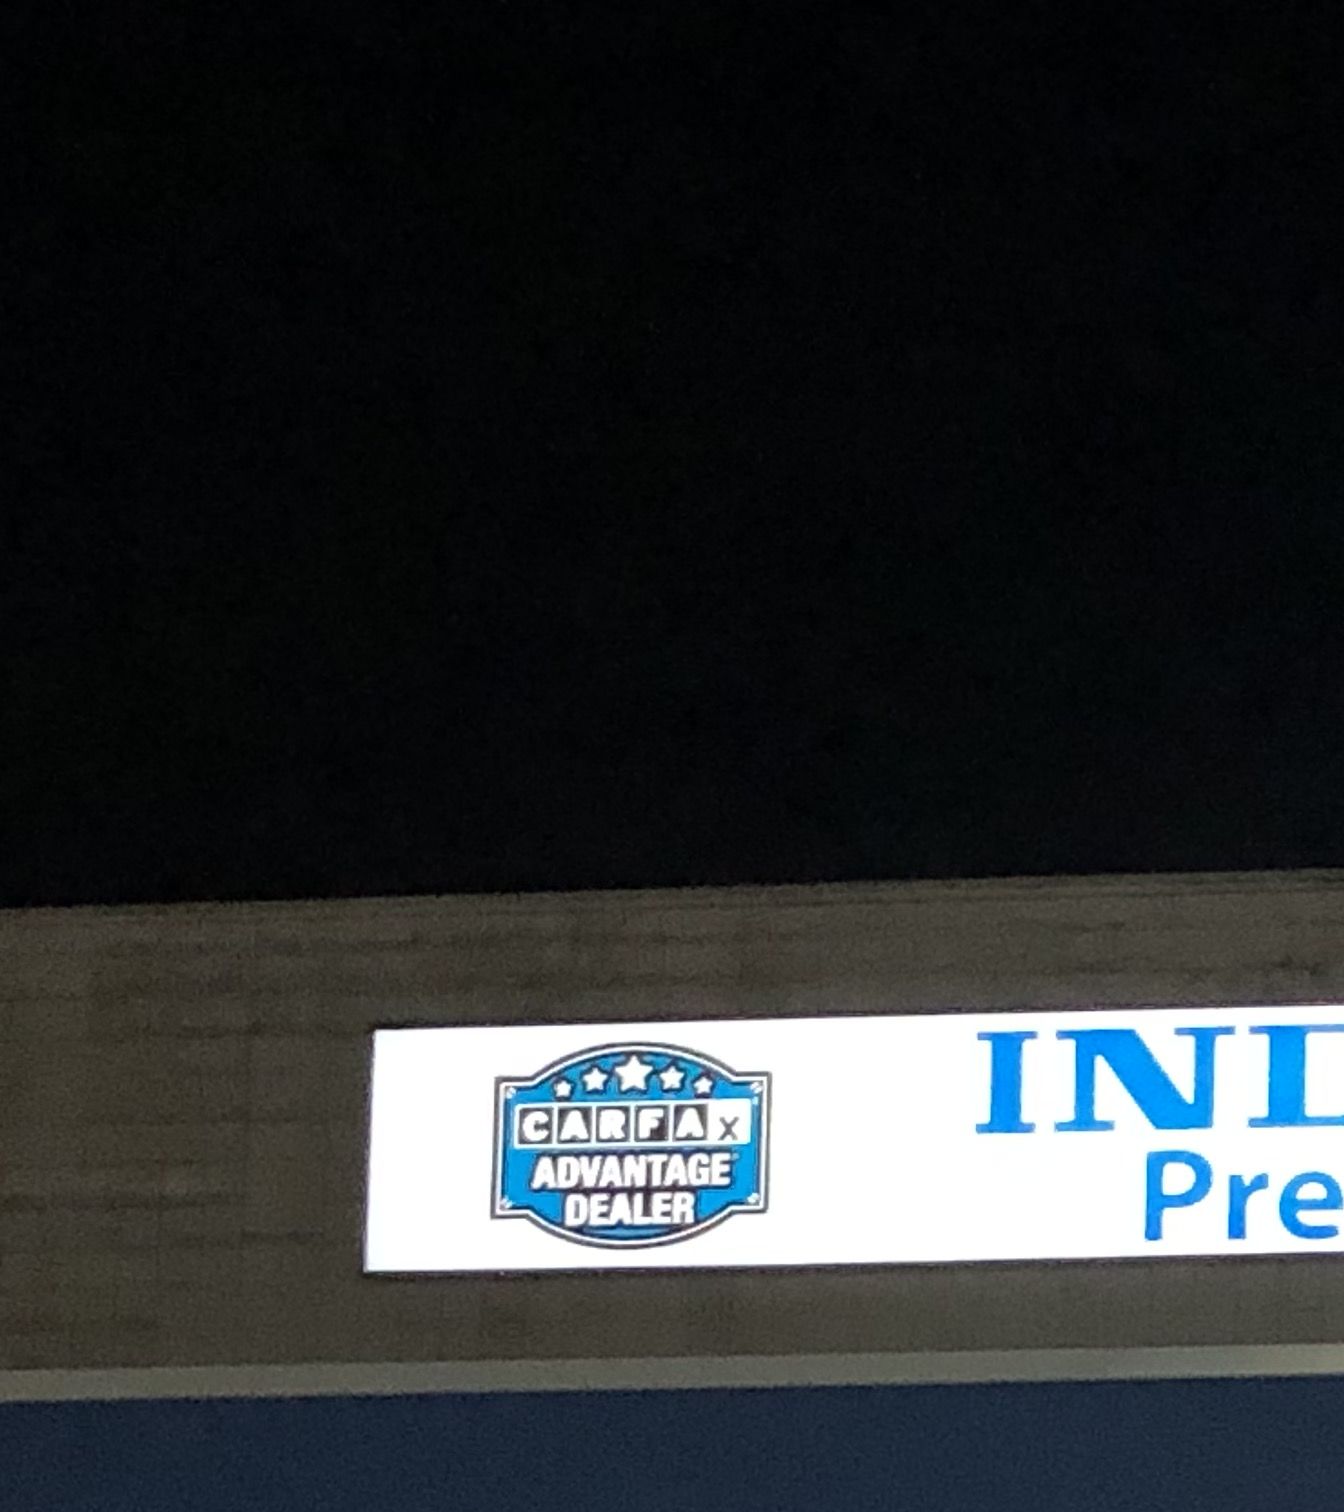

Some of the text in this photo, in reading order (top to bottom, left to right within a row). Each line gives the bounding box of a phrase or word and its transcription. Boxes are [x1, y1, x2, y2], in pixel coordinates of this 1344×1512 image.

[519, 1103, 740, 1145] CARFAX
[530, 1152, 732, 1190] ADVANTAGE
[563, 1191, 696, 1228] DEALER
